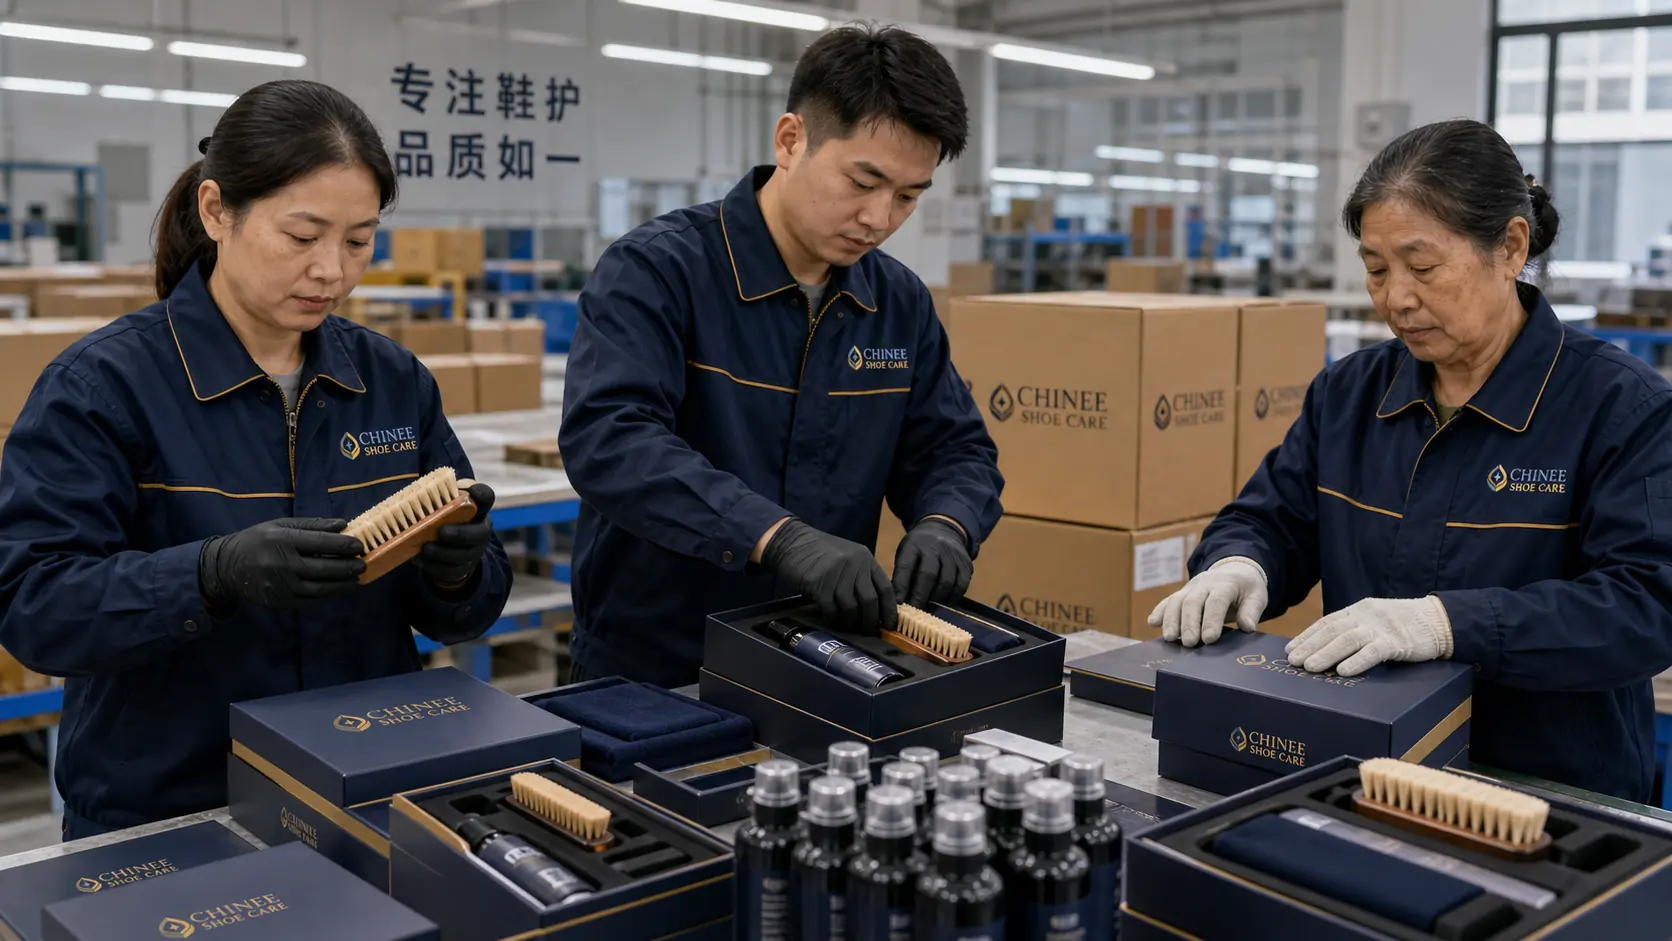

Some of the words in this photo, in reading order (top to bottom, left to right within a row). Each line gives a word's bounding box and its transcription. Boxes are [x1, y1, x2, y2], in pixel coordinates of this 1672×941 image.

[390, 62, 580, 122] 专注鞋护
[395, 130, 581, 180] 品质如一
[863, 348, 908, 360] CHINEE
[865, 360, 887, 370] SHOE
[887, 360, 909, 369] CARE
[1017, 385, 1108, 412] CHINEE
[1021, 410, 1061, 426] SHOE
[1066, 413, 1108, 430] CARE
[359, 426, 416, 446] CHINEE
[364, 444, 391, 456] SHOE
[392, 440, 418, 452] CARE
[1510, 468, 1567, 482] CHINEE
[1509, 483, 1536, 492] SHOE
[1538, 483, 1566, 493] CARE
[1020, 597, 1097, 625] CHINEE
[366, 696, 462, 720] CHINEE
[379, 711, 425, 726] SHOE
[427, 704, 472, 716] CARE
[1249, 731, 1306, 756] CHINEE
[1249, 745, 1276, 759] SHOE
[1278, 752, 1305, 767] CARE
[98, 858, 173, 882] CHINEE
[190, 893, 281, 923] CHINEE
[201, 913, 246, 931] SHOE
[247, 902, 289, 918] CARE
